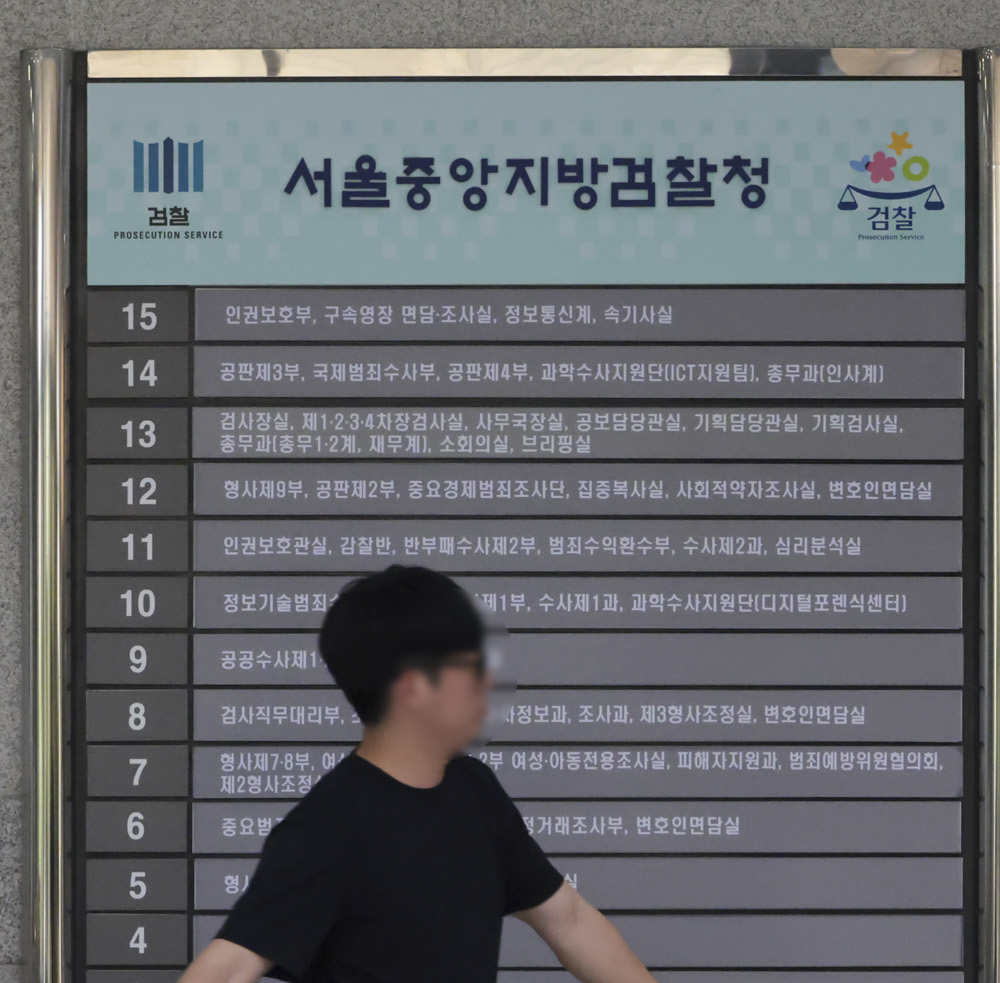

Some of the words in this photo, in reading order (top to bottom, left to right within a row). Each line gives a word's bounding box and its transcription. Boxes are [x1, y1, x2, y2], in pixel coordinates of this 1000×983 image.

[284, 154, 769, 211] 서울중앙지방검찰청
[148, 206, 190, 226] 검찰
[867, 206, 916, 230] 검찰
[114, 231, 180, 239] PROSECUTION
[184, 231, 223, 239] SERVICE
[122, 303, 157, 330] 15
[226, 305, 316, 324] 인권보호부,
[325, 305, 393, 324] 구속영장
[505, 305, 596, 324] 정보통신계,
[605, 305, 672, 324] 속기사실
[122, 360, 157, 386] 14
[221, 363, 305, 382] 공판제3부,
[313, 363, 440, 382] 국제범죄수사부,
[448, 363, 533, 382] 공판제4부,
[121, 420, 156, 448] 13
[221, 412, 293, 431] 검사장실,
[477, 412, 568, 431] 사무국장실,
[577, 413, 686, 432] 공보담당관실,
[695, 413, 803, 433] 기획담당관실,
[812, 414, 903, 433] 기획검사실,
[440, 435, 513, 454] 소회의실,
[522, 435, 590, 454] 브리핑실
[122, 478, 156, 504] 12
[224, 480, 308, 499] 형사제9부,
[316, 480, 400, 499] 공판제2부,
[408, 480, 569, 499] 중요경제범죄조사단,
[578, 480, 668, 499] 집중복사실,
[677, 480, 821, 500] 사회적약자조사실,
[829, 481, 932, 500] 변호인면담실
[122, 534, 152, 560] 11
[224, 537, 332, 555] 인권보호관실,
[340, 537, 395, 555] 감찰반,
[405, 537, 541, 555] 반부패수사제2부,
[550, 536, 675, 555] 범죄수익환수부,
[684, 537, 767, 555] 수사제2과,
[776, 537, 861, 555] 심리분석실
[121, 589, 155, 617] 10
[539, 594, 623, 612] 수사제1과,
[130, 645, 147, 673] 9
[129, 702, 146, 730] 8
[222, 706, 344, 725] 검사직무대리부,
[579, 705, 633, 724] 조사과,
[640, 705, 757, 724] 제3형사조정실,
[765, 705, 866, 724] 변호인면담실
[129, 759, 147, 785] 7
[678, 752, 782, 770] 피해자지원과,
[790, 752, 943, 771] 범죄예방위원협의회,
[127, 812, 144, 840] 6
[637, 817, 739, 835] 변호인면담실
[129, 872, 146, 899] 5
[130, 927, 147, 954] 4
